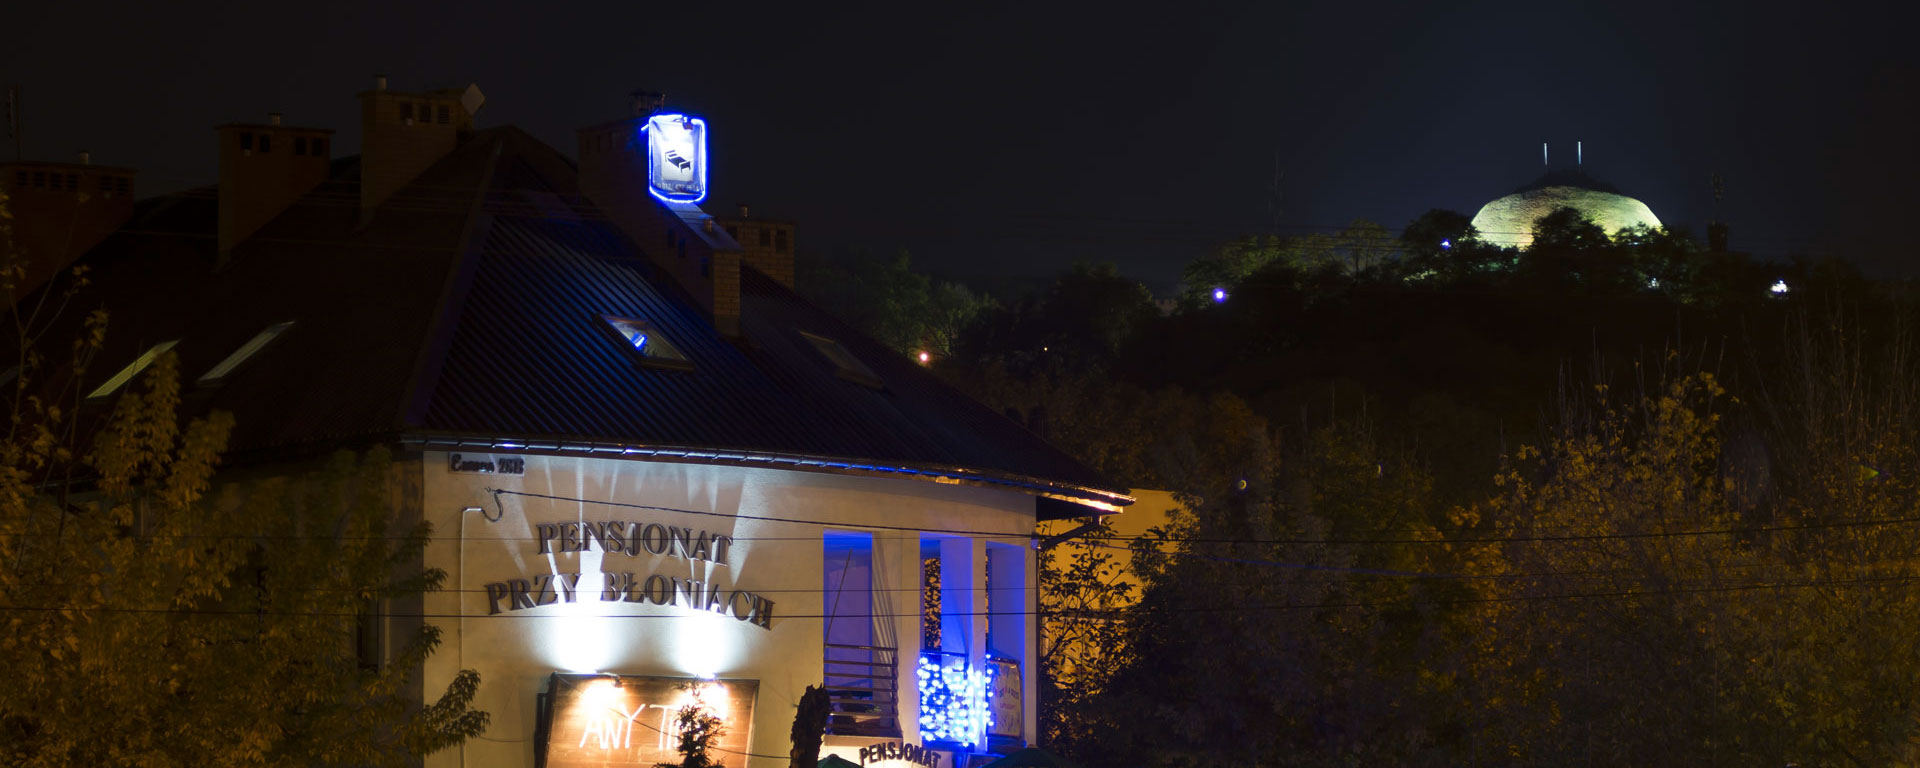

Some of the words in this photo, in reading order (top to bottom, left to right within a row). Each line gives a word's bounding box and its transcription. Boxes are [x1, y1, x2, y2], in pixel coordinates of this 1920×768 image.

[536, 520, 734, 567] PENSJONAT
[484, 571, 583, 616] PRZY
[600, 570, 776, 631] BŁONIACH
[578, 703, 646, 749] ANY
[858, 741, 942, 768] PENSJONAT
